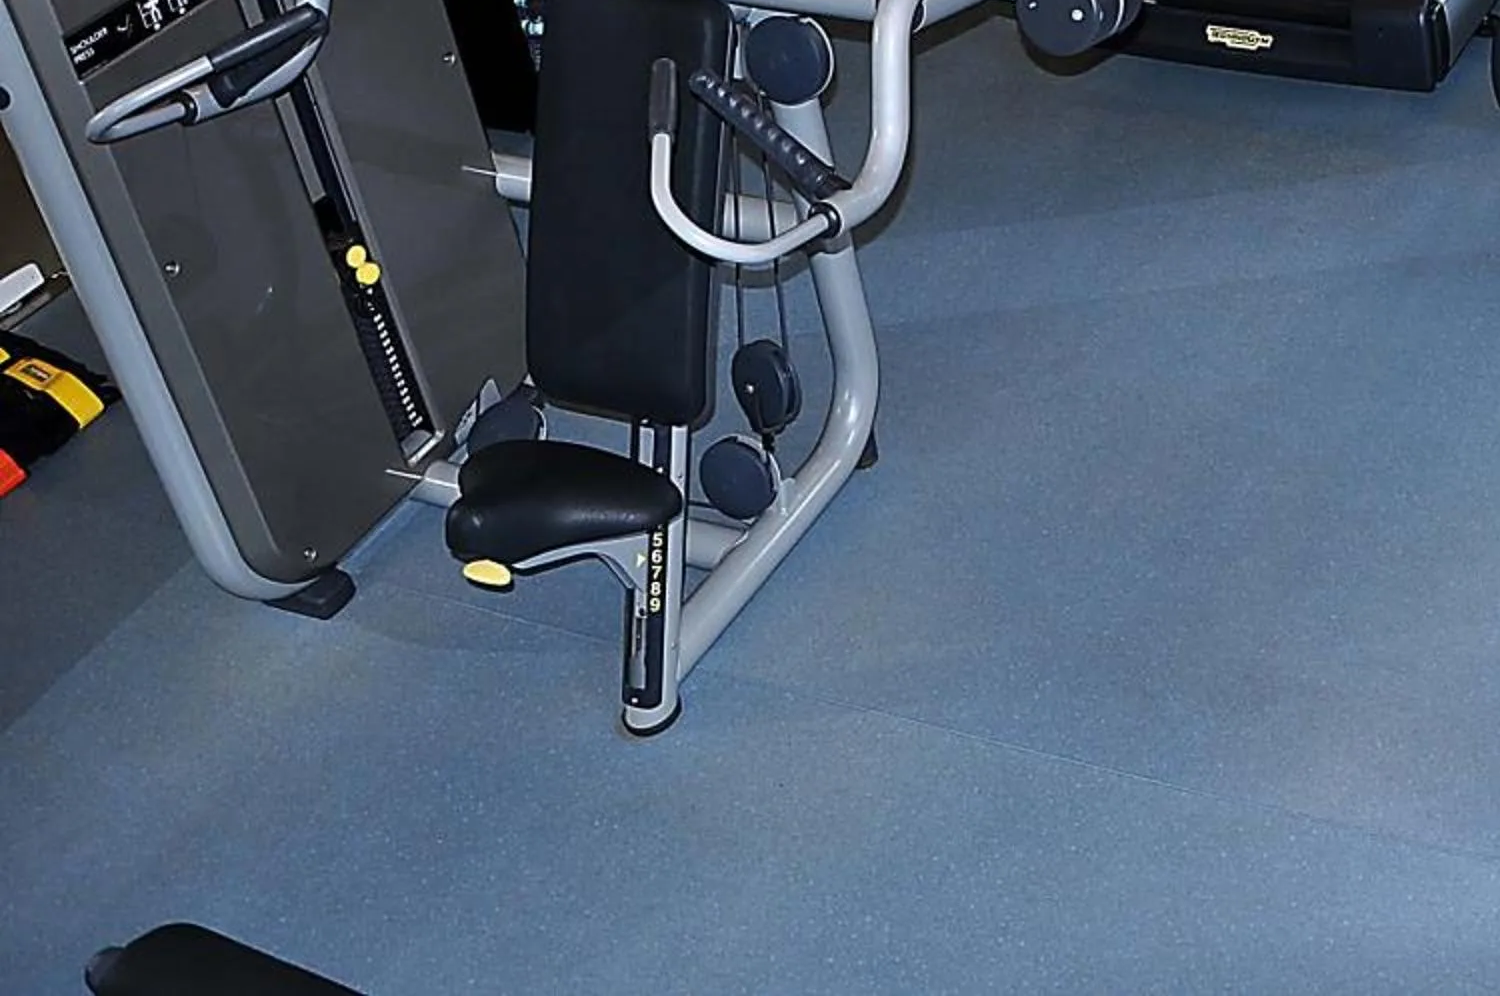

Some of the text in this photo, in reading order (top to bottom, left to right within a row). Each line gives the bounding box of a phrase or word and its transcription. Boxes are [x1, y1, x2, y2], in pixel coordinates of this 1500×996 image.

[69, 26, 108, 54] SHOULDER
[73, 47, 96, 65] PRESS
[652, 531, 663, 547] 5
[651, 549, 662, 564] 6
[651, 565, 662, 580] 7
[650, 581, 661, 596] 8
[649, 597, 661, 613] 9
